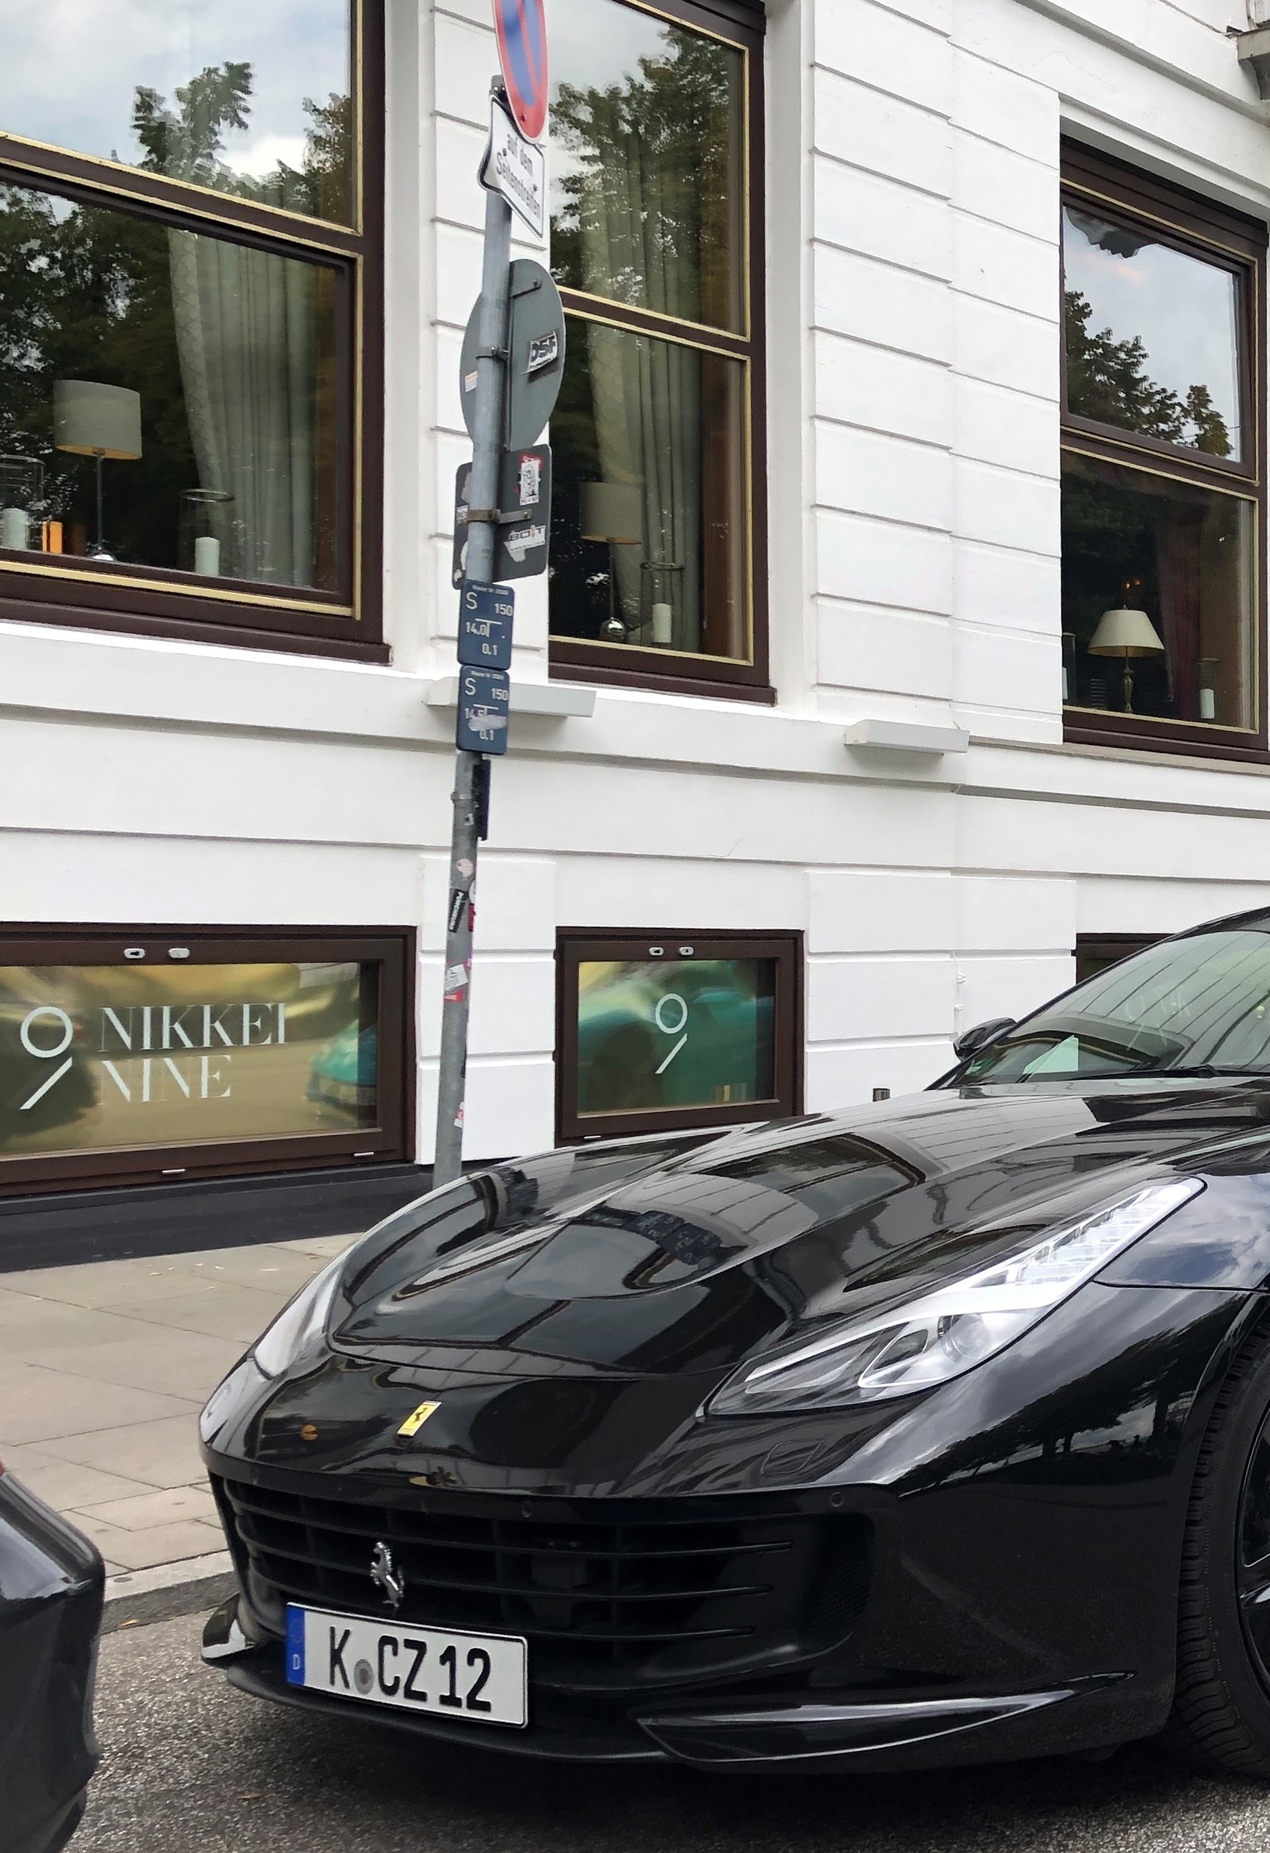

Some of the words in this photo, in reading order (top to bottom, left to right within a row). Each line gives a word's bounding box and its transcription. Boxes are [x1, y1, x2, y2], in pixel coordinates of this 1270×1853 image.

[465, 591, 478, 610] S
[494, 602, 513, 617] 150
[464, 677, 477, 696] S
[491, 687, 509, 701] 150
[97, 1002, 287, 1053] NIKKEI
[97, 1054, 232, 1105] NINE
[292, 1653, 301, 1671] D
[328, 1625, 351, 1689] K
